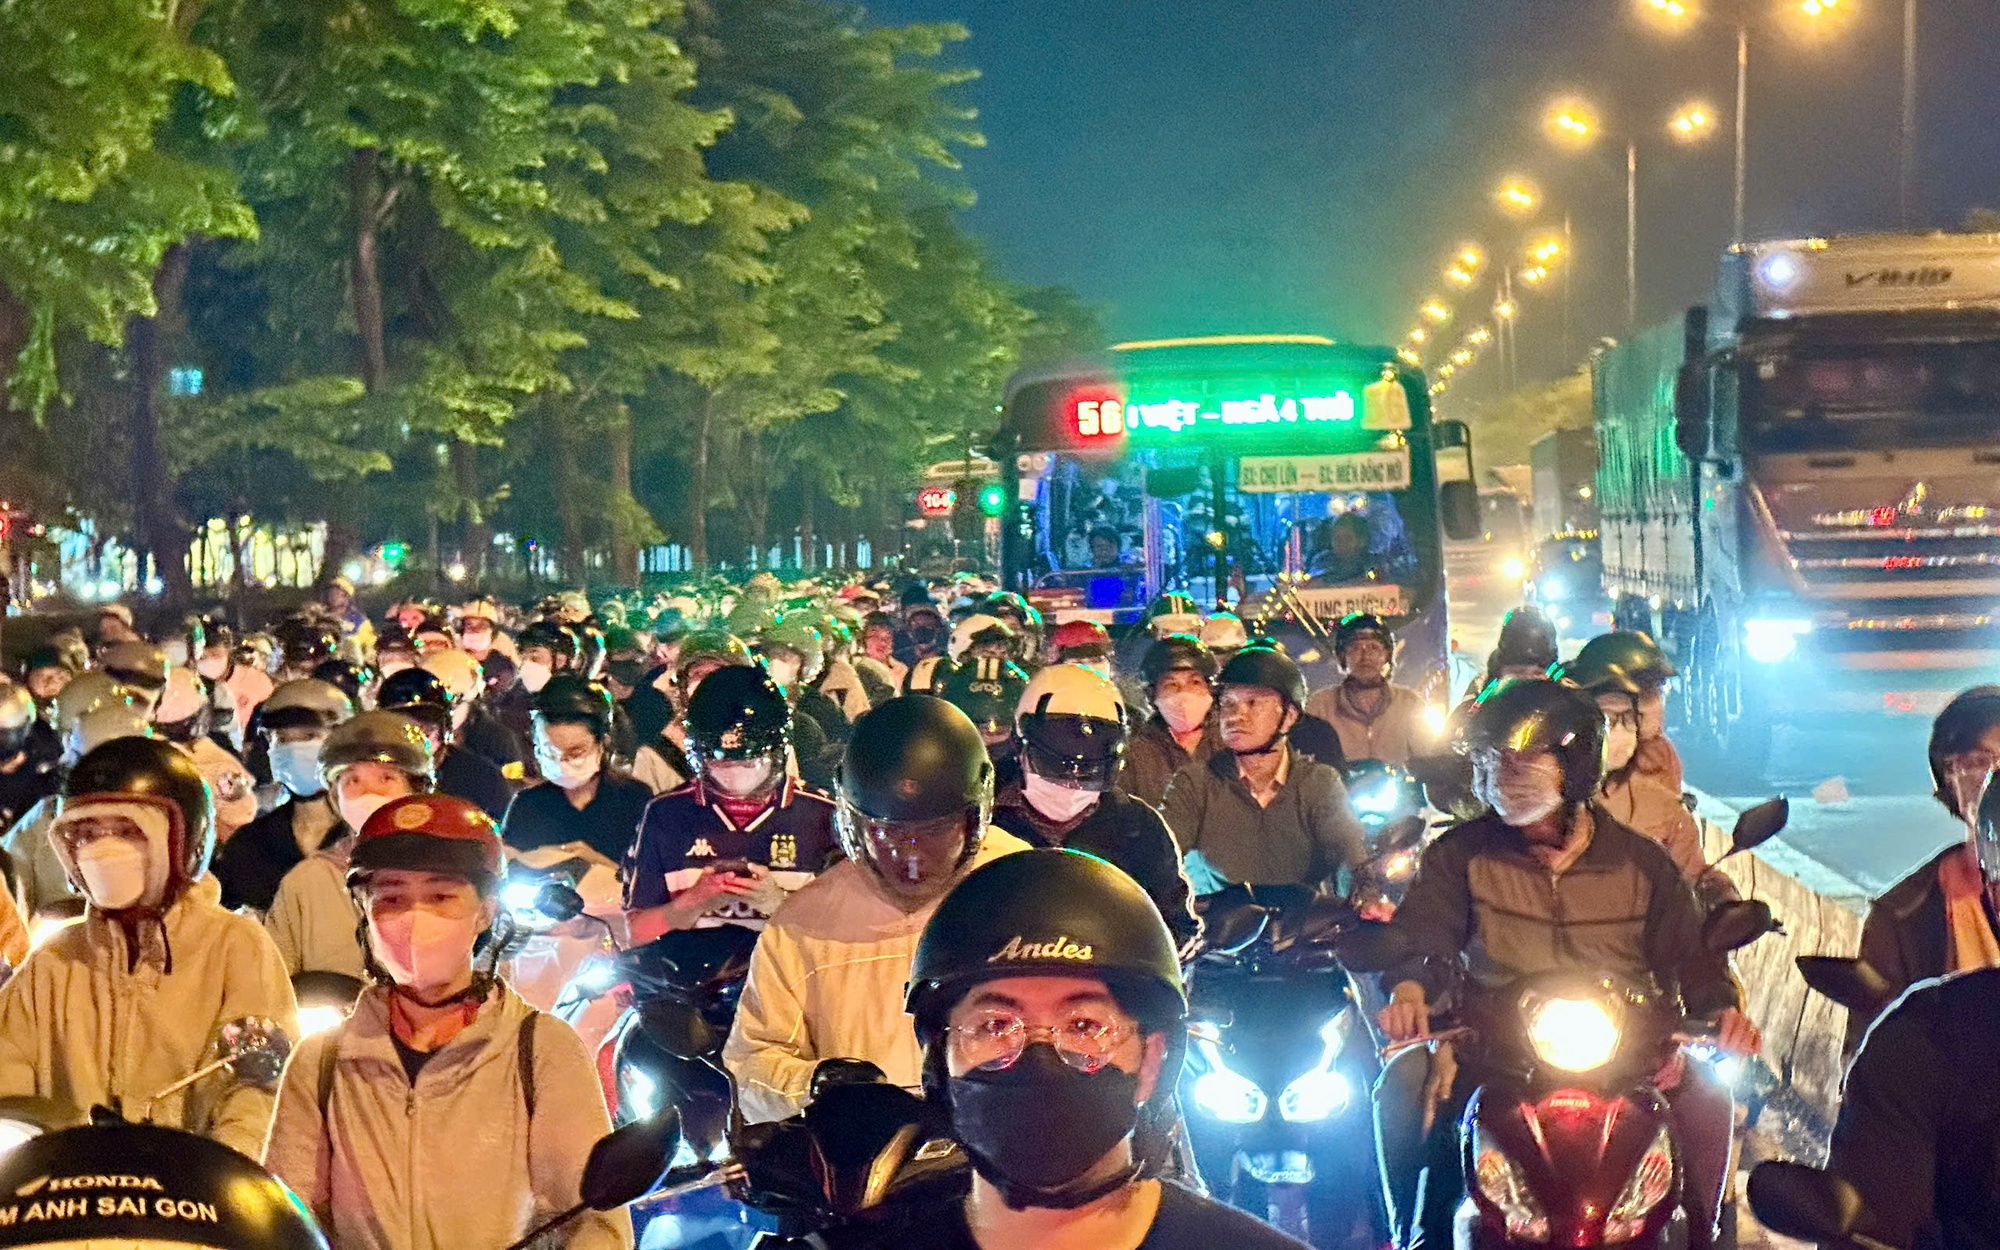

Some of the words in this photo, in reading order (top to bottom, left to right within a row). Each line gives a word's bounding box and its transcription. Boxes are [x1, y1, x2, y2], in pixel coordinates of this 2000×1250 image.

[1078, 400, 1122, 435] 56
[1279, 398, 1298, 423] 4
[987, 935, 1094, 961] Andes
[48, 1173, 164, 1192] HONDA
[22, 1197, 87, 1222] ANH
[97, 1196, 147, 1217] SAI
[155, 1197, 218, 1223] GON
